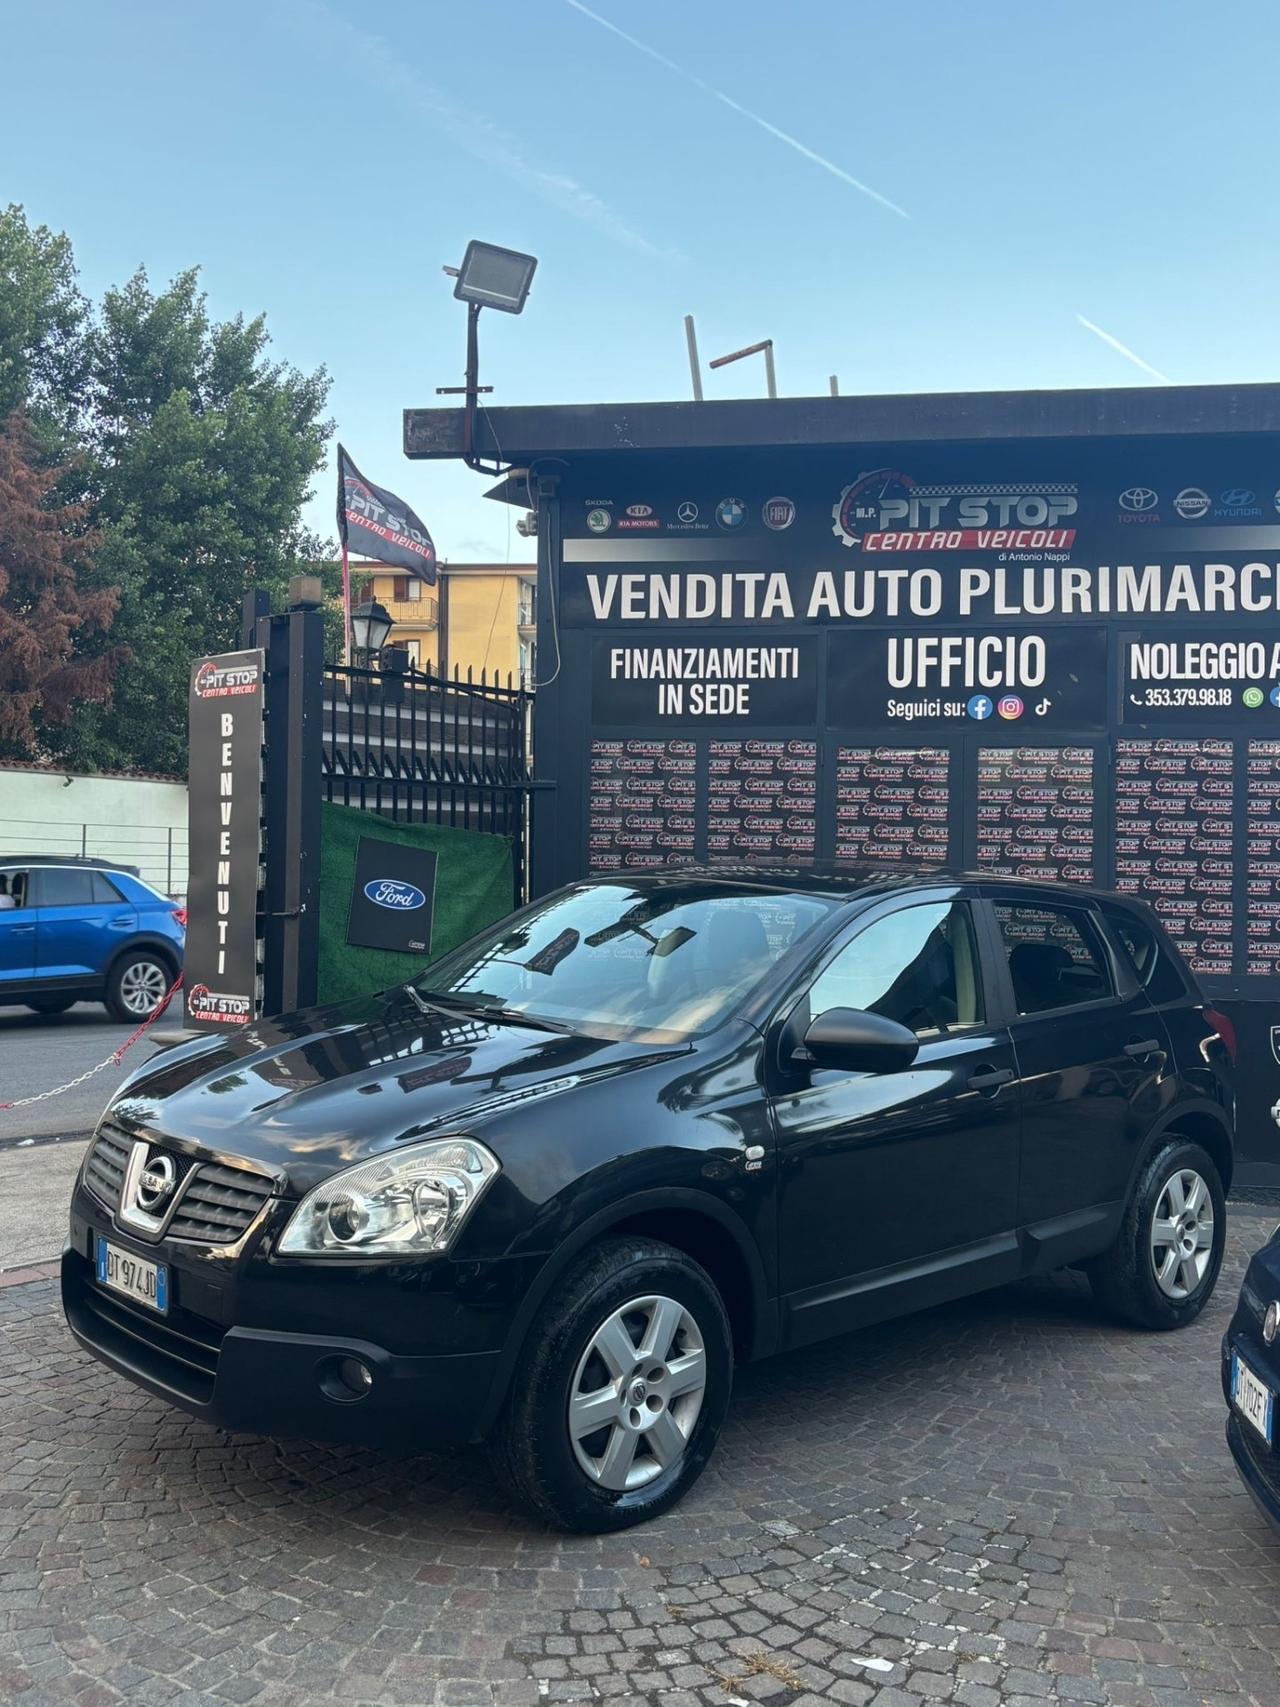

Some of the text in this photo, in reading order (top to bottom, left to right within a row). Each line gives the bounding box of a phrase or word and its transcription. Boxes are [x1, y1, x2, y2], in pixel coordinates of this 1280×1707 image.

[350, 495, 385, 522] PIT
[770, 506, 788, 521] FIAT
[880, 496, 1078, 530] PIT STOP
[1118, 514, 1160, 524] TOYOTA
[1214, 508, 1262, 517] HYUNDAI
[998, 552, 1070, 562] di Antonio Nappi
[586, 562, 1280, 619] VENDITA AUTO PLURIMARC
[611, 647, 799, 679] FINANZIAMENTI
[888, 635, 1046, 688] UFFICIO
[1131, 642, 1266, 679] NOLEGGIO
[206, 670, 258, 688] PIT STOP
[658, 683, 749, 715] IN SEDE
[1145, 688, 1232, 706] 353.379.98.18
[887, 698, 966, 721] Seguici su:
[216, 713, 234, 975] BENVENUTI
[375, 882, 415, 906] Ford
[199, 997, 250, 1014] PIT STOP
